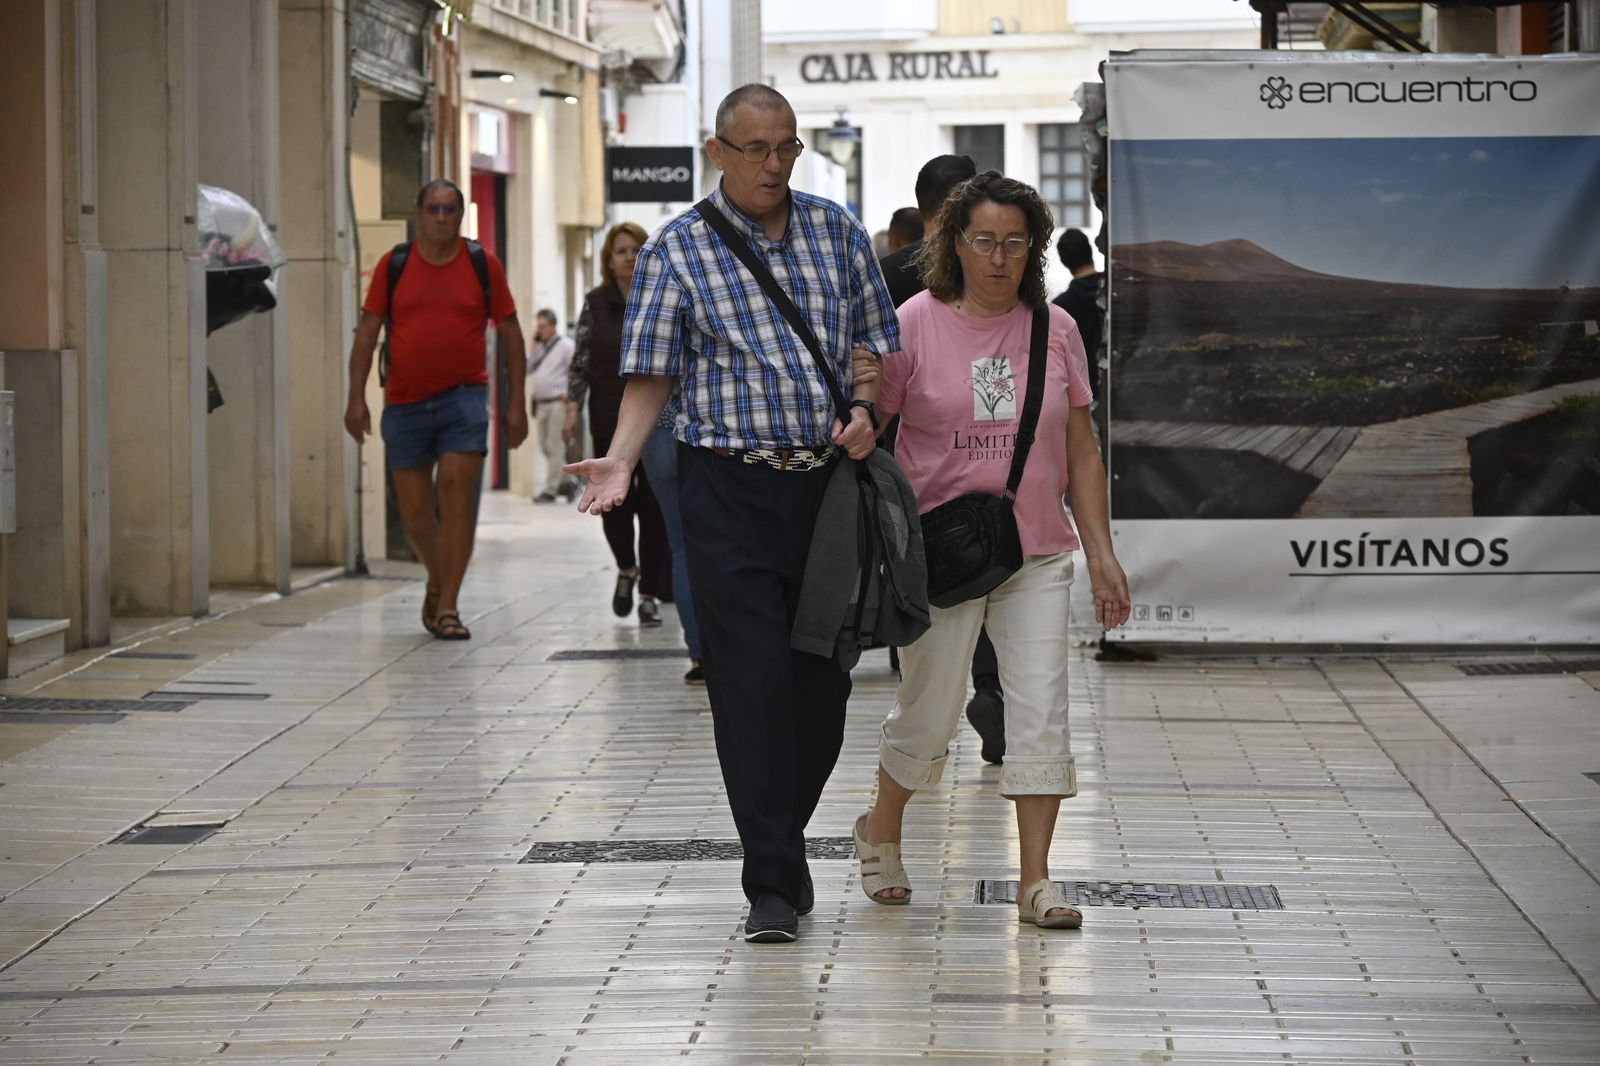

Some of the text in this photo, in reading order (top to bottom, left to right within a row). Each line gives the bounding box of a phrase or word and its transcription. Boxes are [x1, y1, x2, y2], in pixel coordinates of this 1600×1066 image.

[801, 50, 999, 83] CAJA RURAL
[1298, 76, 1538, 103] encuentro
[612, 166, 690, 183] MANGO
[953, 431, 1018, 449] LIMIT
[968, 450, 1012, 460] EDITIO
[1289, 532, 1509, 568] VISÍTANOS
